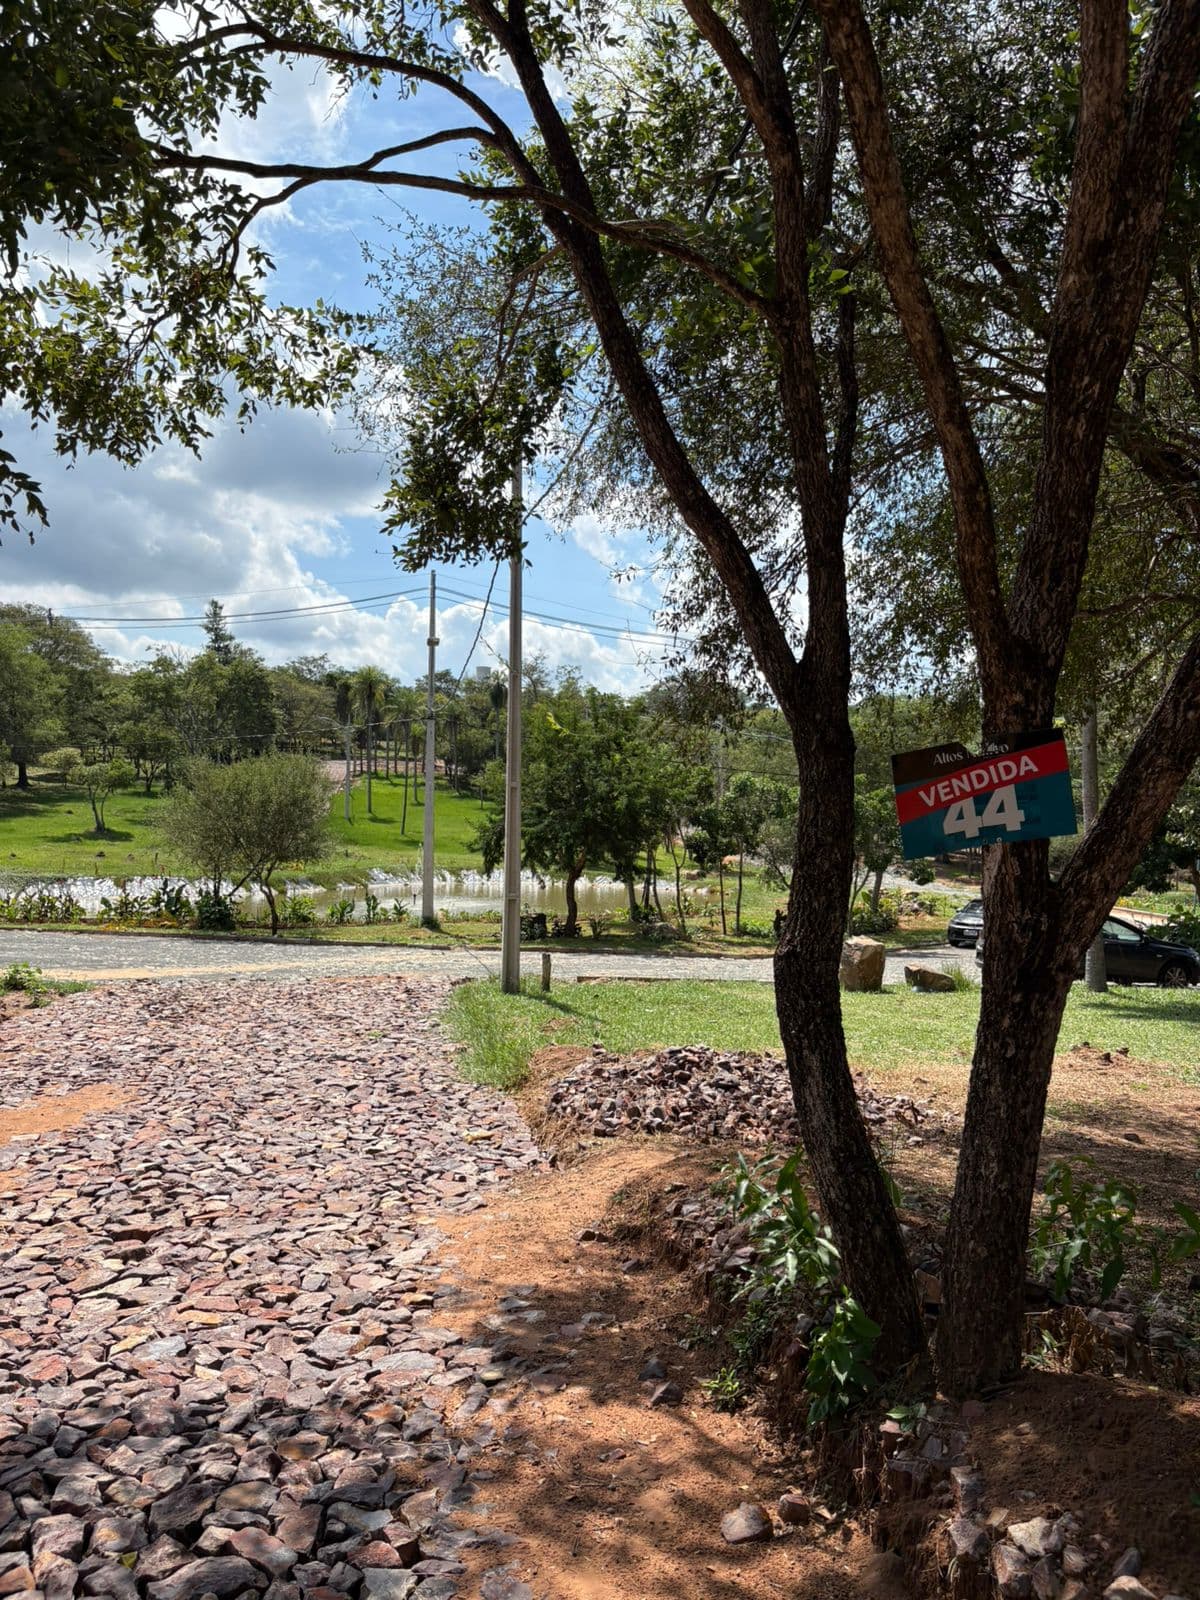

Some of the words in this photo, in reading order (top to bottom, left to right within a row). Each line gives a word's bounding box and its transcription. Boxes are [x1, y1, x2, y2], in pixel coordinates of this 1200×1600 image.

[918, 755, 1039, 807] VENDIDA
[933, 752, 964, 766] Altos
[943, 784, 1026, 839] 44
